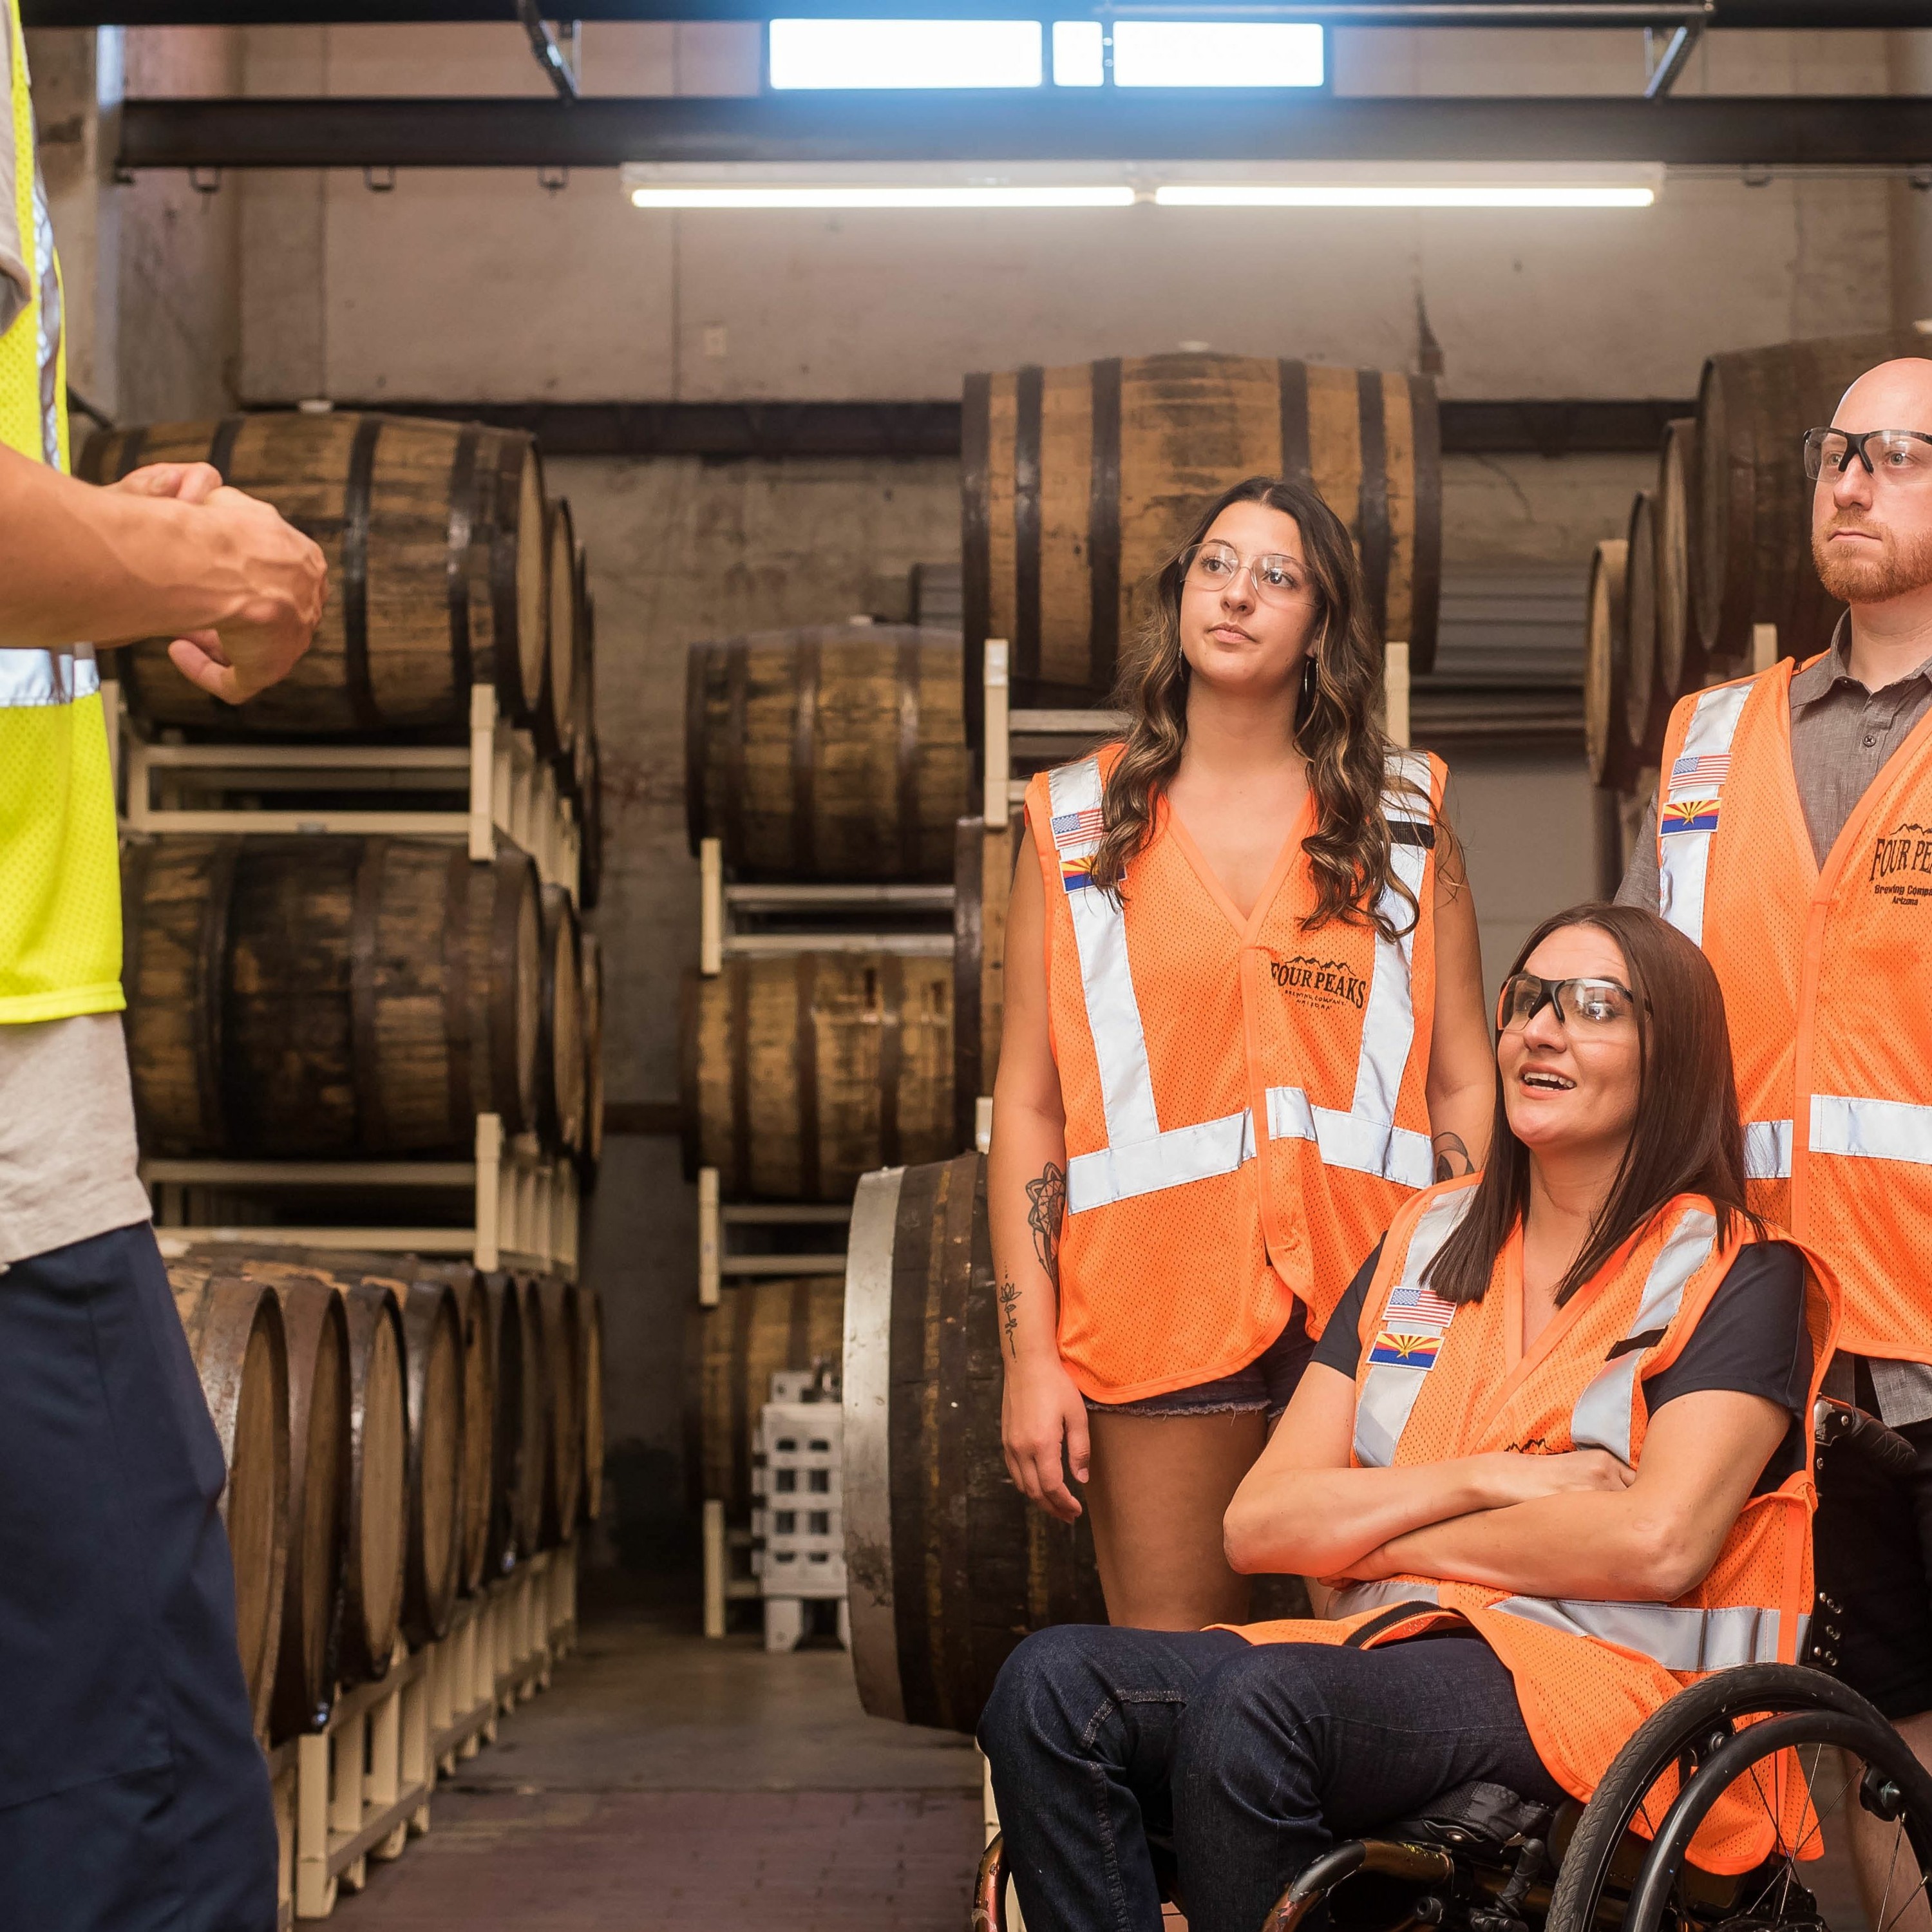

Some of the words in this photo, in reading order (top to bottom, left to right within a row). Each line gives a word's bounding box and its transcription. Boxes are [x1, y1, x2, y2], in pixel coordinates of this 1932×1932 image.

[1869, 838, 1911, 882] FOUR
[1875, 884, 1905, 895] Brewing
[1892, 896, 1918, 905] Arizona
[1271, 961, 1312, 989] FOUR
[1314, 972, 1367, 1009] PEAKS
